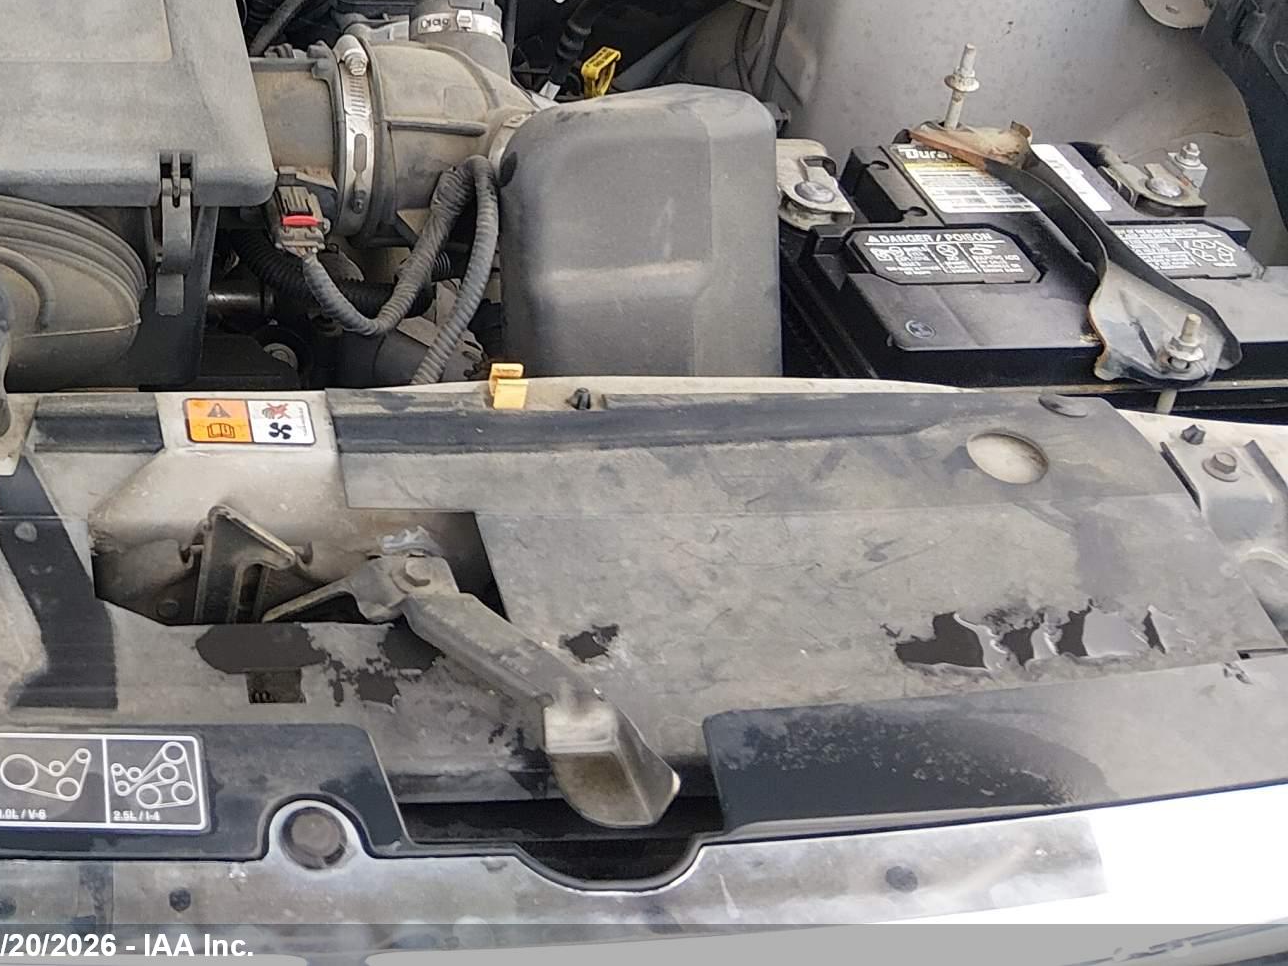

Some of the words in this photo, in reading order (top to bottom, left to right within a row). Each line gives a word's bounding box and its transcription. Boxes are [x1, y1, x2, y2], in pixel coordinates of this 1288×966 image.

[900, 147, 953, 160] Dura
[879, 233, 934, 243] DANGER
[946, 232, 993, 242] POISON
[28, 809, 47, 820] V-6
[113, 810, 137, 821] 2.5L
